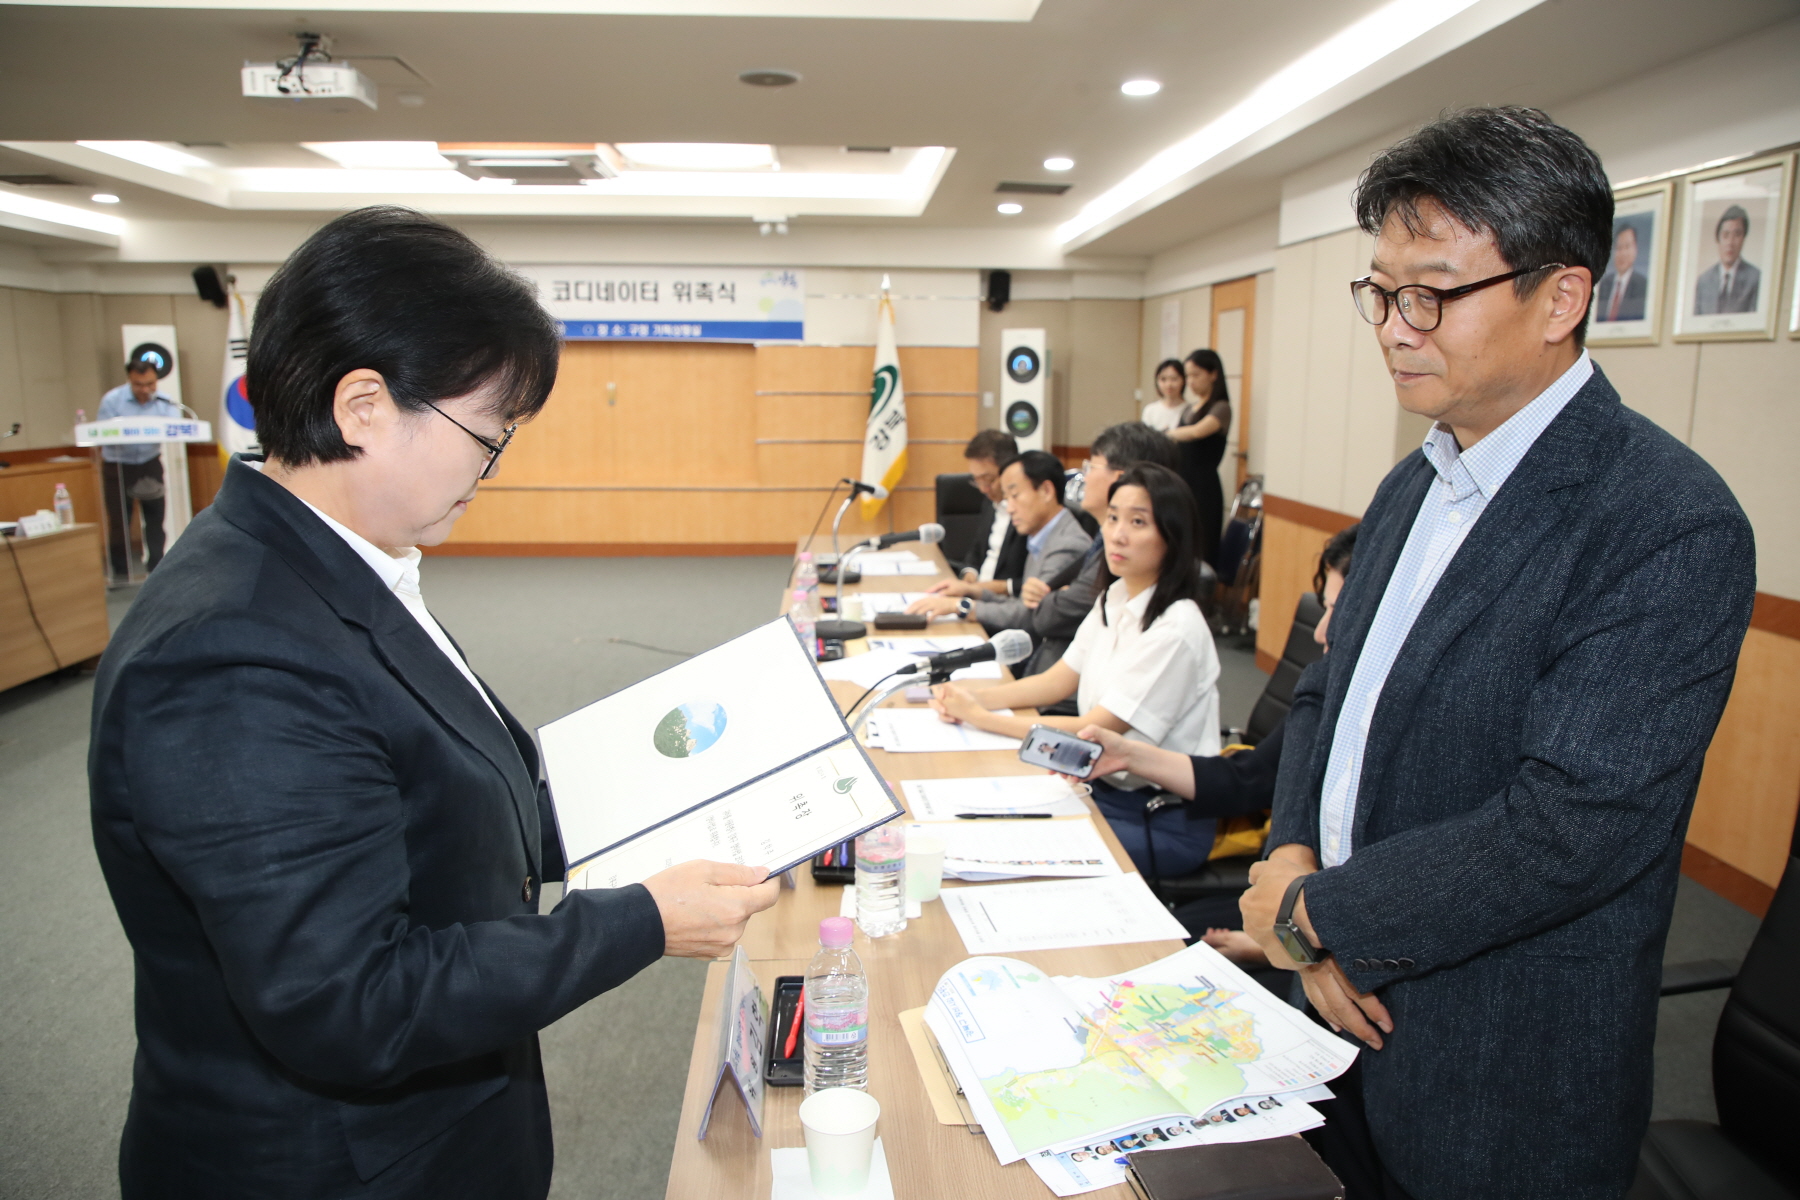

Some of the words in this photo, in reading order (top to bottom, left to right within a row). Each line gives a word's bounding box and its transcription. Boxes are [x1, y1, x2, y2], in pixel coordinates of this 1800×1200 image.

[552, 280, 659, 303] 코디네이터
[672, 280, 737, 304] 위촉식
[789, 793, 812, 820] 위촉장
